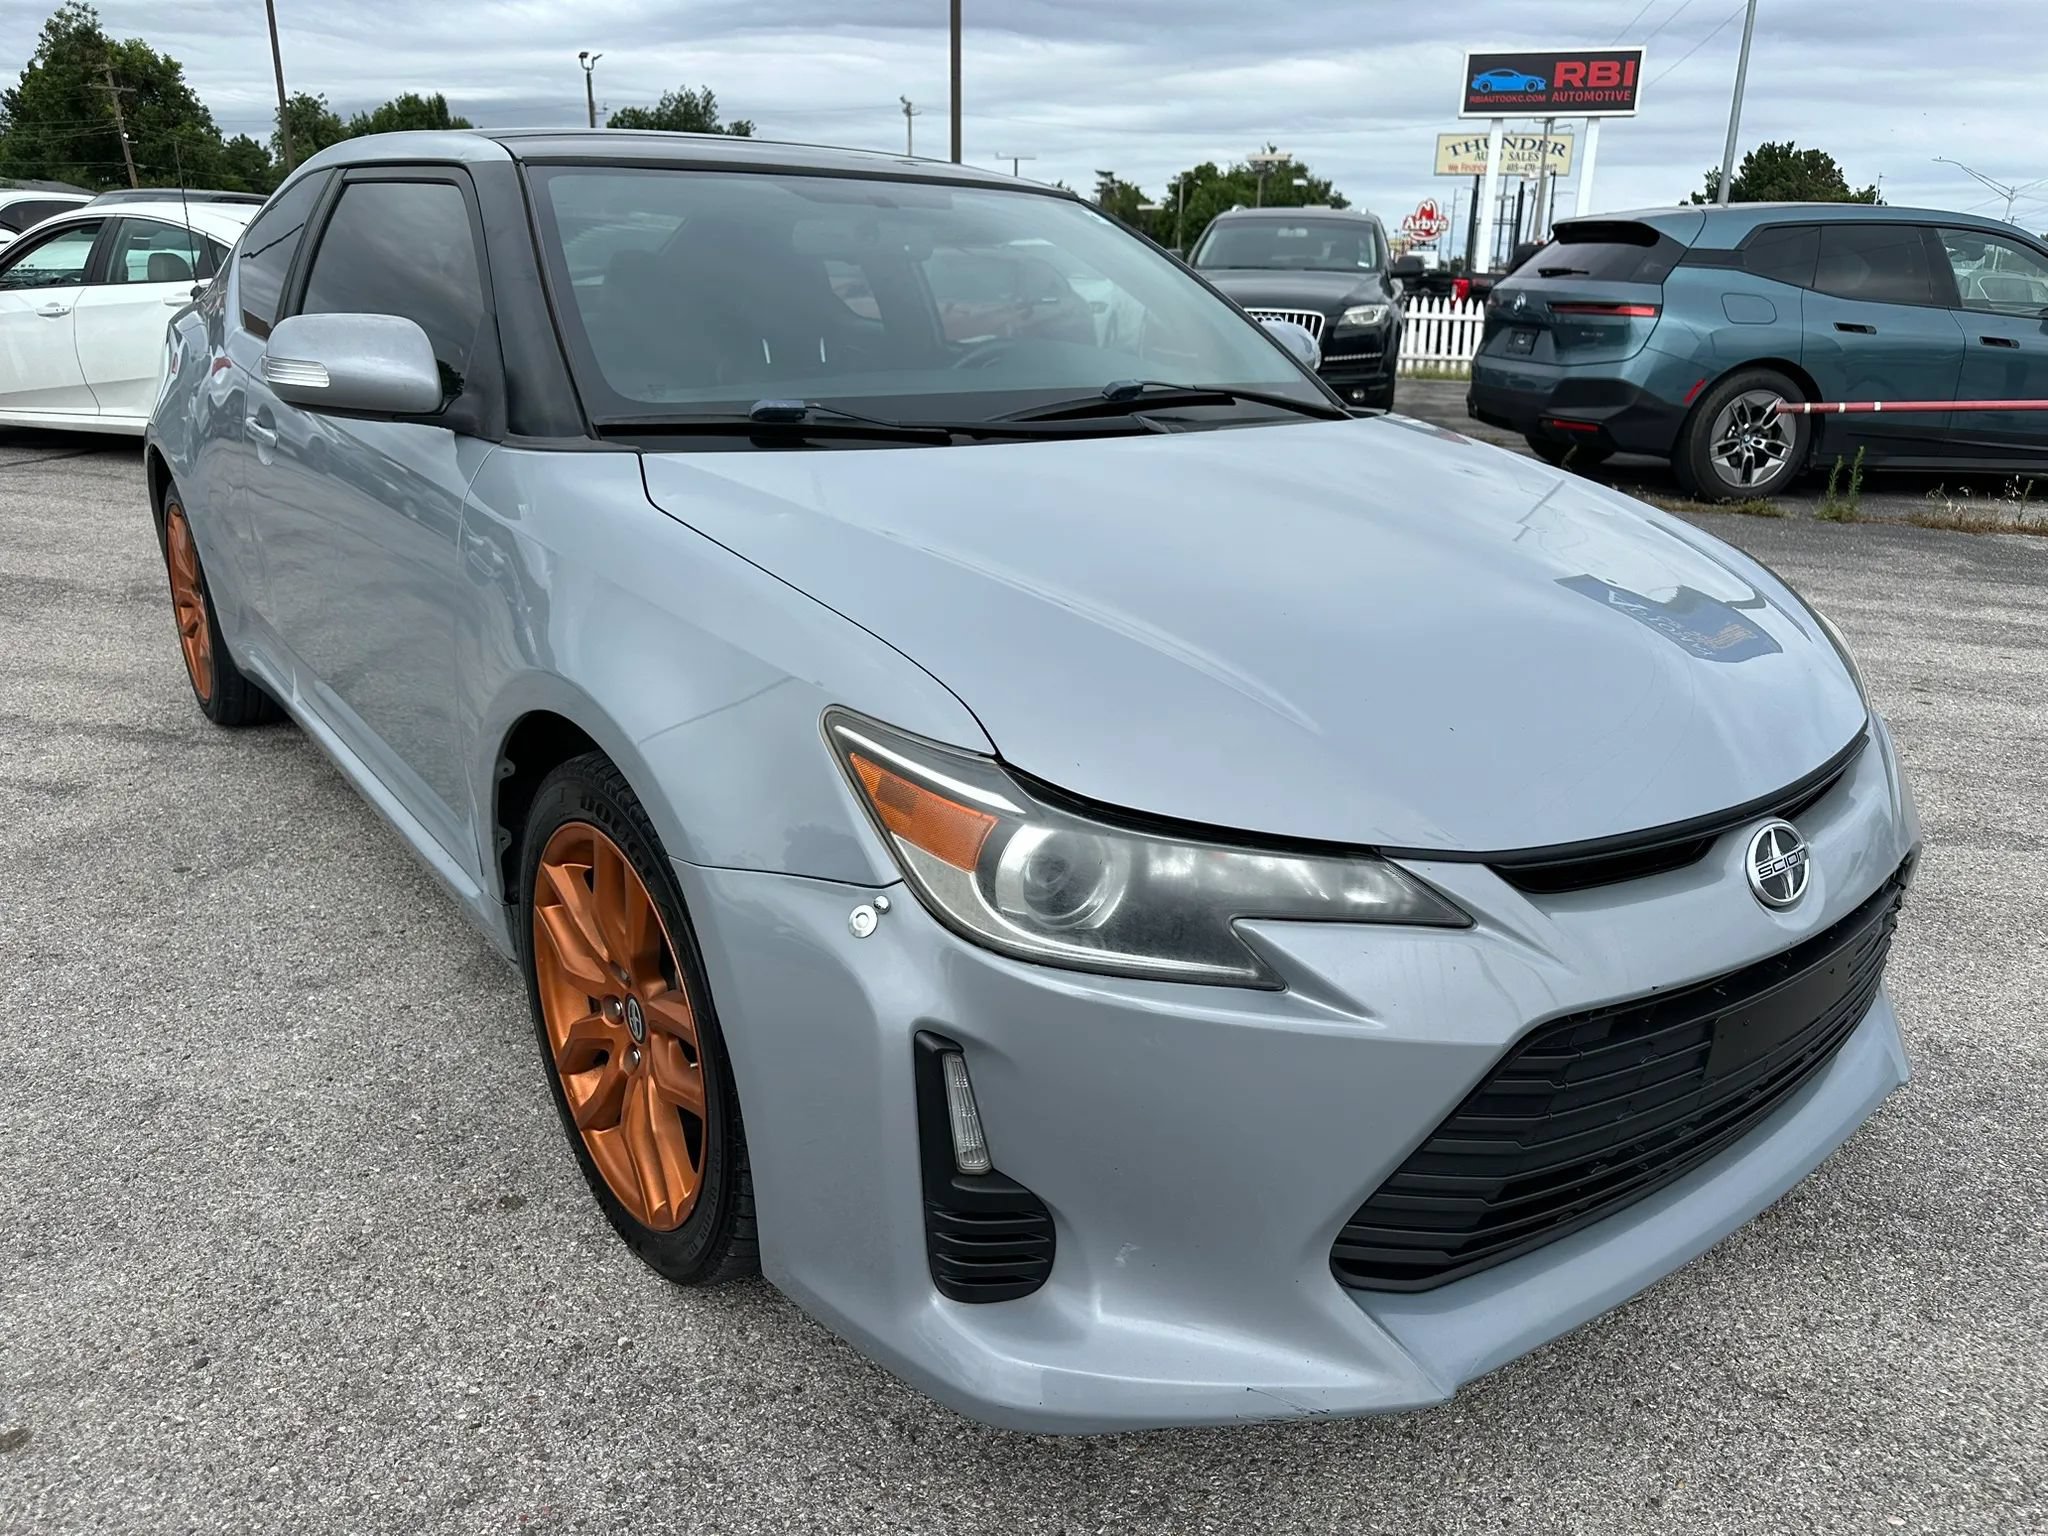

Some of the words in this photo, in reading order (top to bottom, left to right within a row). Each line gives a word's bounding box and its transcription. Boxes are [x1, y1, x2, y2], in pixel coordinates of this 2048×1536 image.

[1554, 61, 1636, 88] RBI
[1551, 90, 1631, 103] AUTOMOTIVE
[1508, 151, 1540, 163] SALES
[1404, 215, 1449, 233] Arby's
[1758, 848, 1806, 879] SCION
